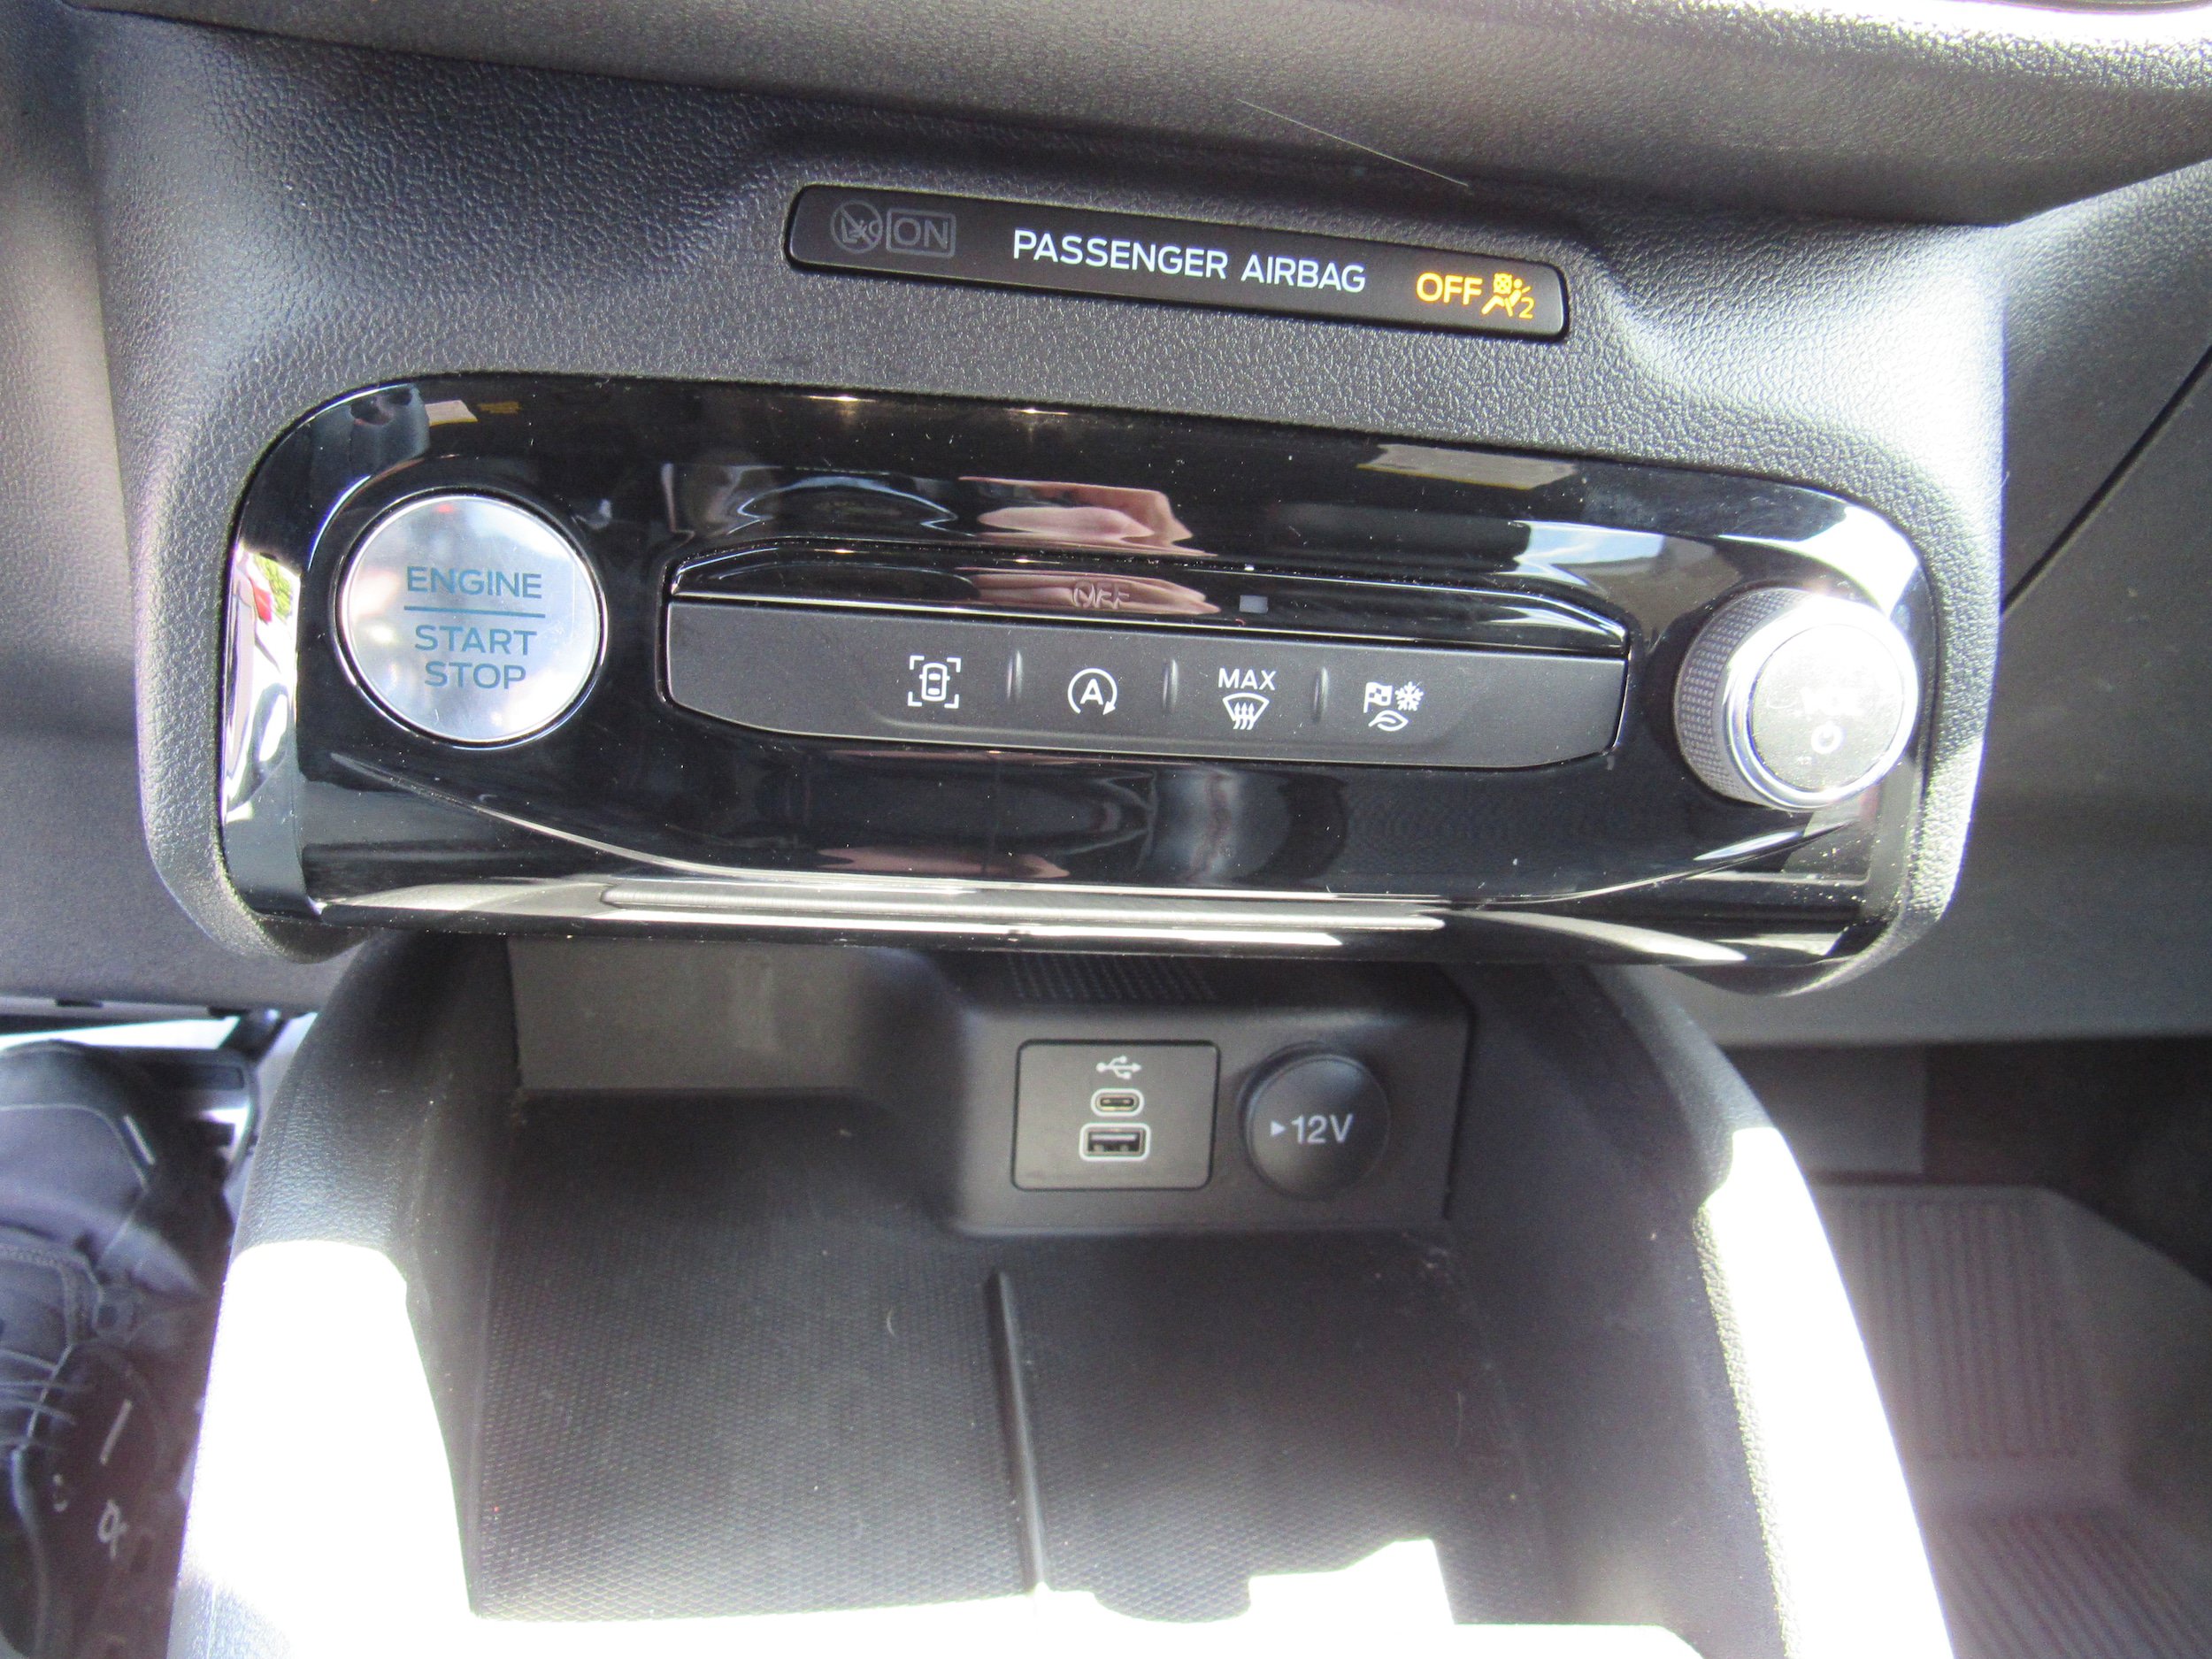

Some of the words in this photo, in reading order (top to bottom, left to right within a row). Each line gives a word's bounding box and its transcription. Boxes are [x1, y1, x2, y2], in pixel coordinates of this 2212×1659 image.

[893, 217, 950, 250] ON
[1013, 228, 1228, 280] PASSENGER
[1240, 253, 1366, 293] AIRBAG
[1416, 273, 1484, 306] OFF
[406, 566, 542, 600] ENGINE
[414, 625, 538, 656] START
[424, 661, 526, 690] STOP
[1217, 667, 1278, 691] MAX
[1290, 1113, 1354, 1145] 12V
